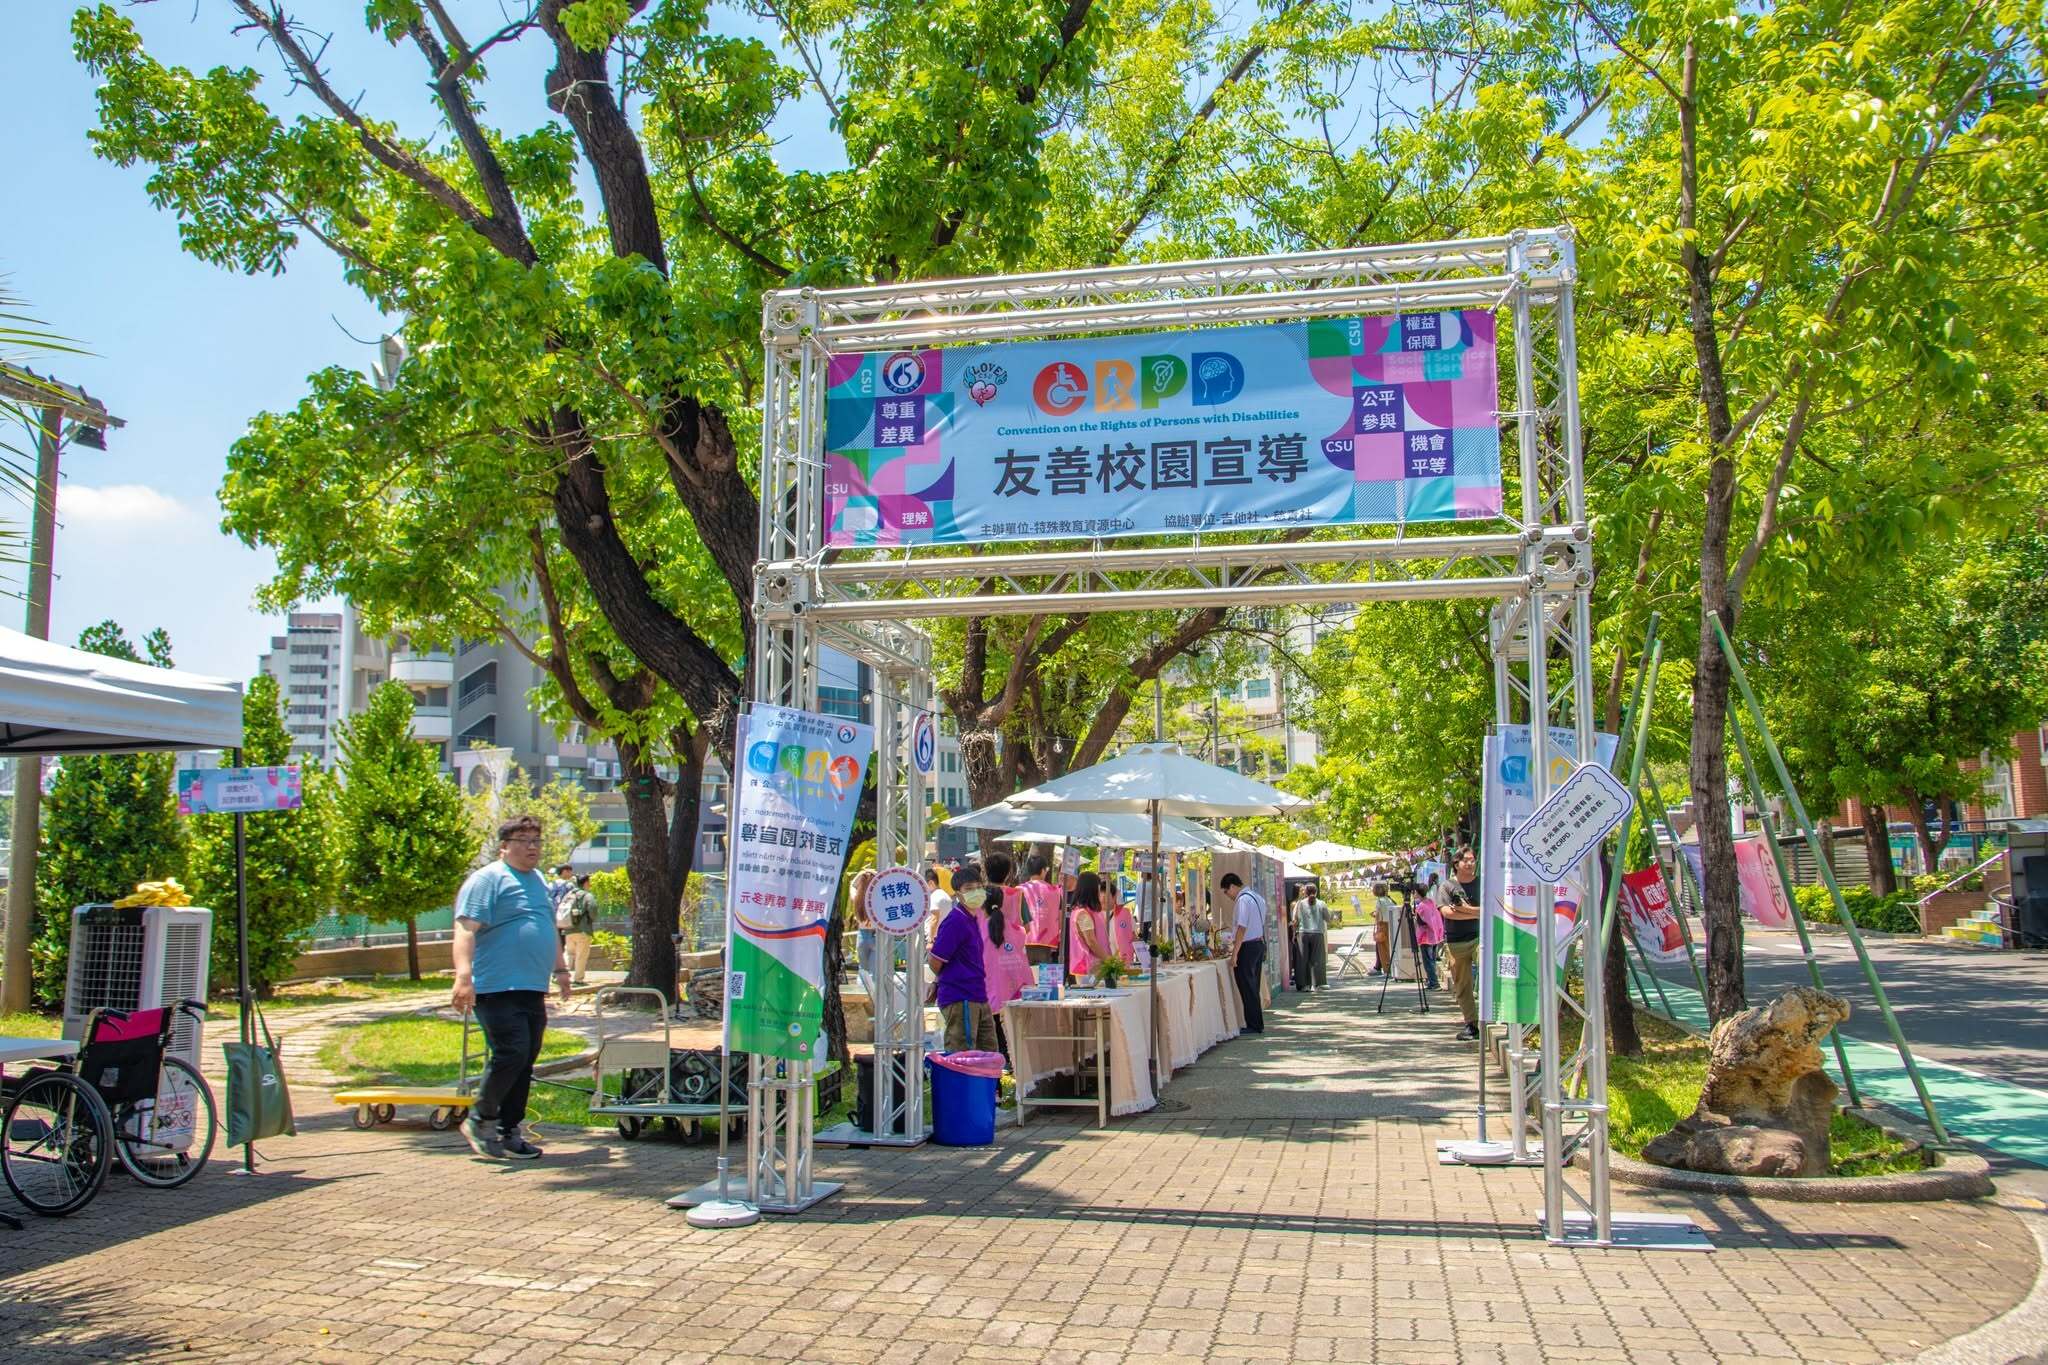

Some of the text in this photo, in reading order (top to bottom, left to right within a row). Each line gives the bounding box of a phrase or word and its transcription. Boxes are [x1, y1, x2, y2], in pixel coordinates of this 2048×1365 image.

[1406, 316, 1436, 331] 權益
[1349, 320, 1361, 346] CSU
[1406, 335, 1437, 350] 保障
[861, 368, 872, 394] CSU
[1033, 352, 1245, 416] CRPD
[1361, 390, 1395, 407] 公平
[881, 401, 916, 419] 尊重
[997, 409, 1300, 436] Convention on the Rights of Persons with Disabilities
[1362, 412, 1396, 430] 參與
[881, 426, 915, 443] 差異
[1411, 434, 1443, 452] 機會
[1326, 440, 1353, 452] CSU
[993, 432, 1309, 497] 友善校園宣導
[1411, 457, 1447, 475] 平等
[825, 484, 848, 495] CSU
[902, 512, 928, 525] 理解
[881, 881, 911, 900] 特教
[885, 902, 915, 921] 宣導
